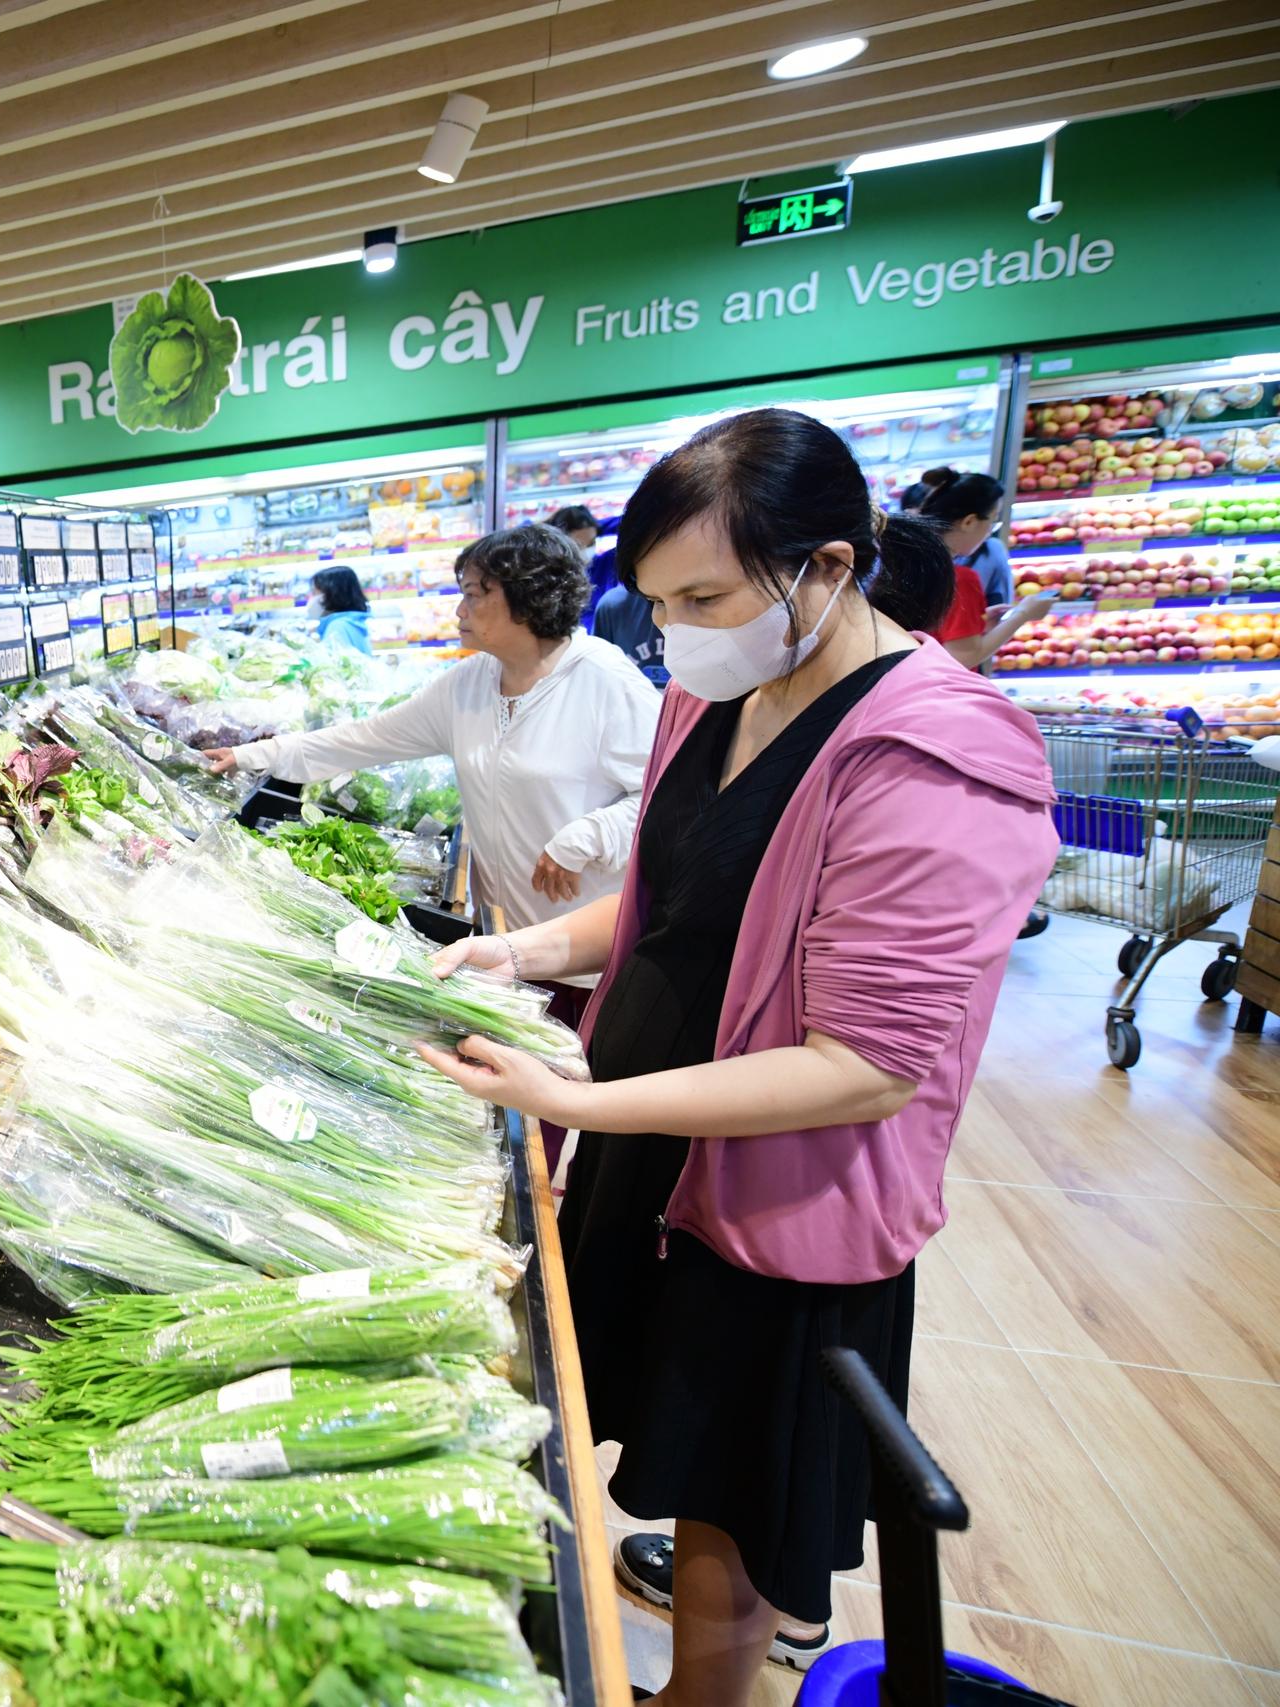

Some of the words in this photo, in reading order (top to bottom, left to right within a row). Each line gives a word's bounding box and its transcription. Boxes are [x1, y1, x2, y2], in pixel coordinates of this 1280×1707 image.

[575, 297, 700, 346] Fruits
[721, 271, 820, 325] and
[846, 233, 1116, 308] Vegetable
[47, 362, 117, 425] Ra
[230, 315, 348, 397] trái
[388, 290, 545, 376] cây
